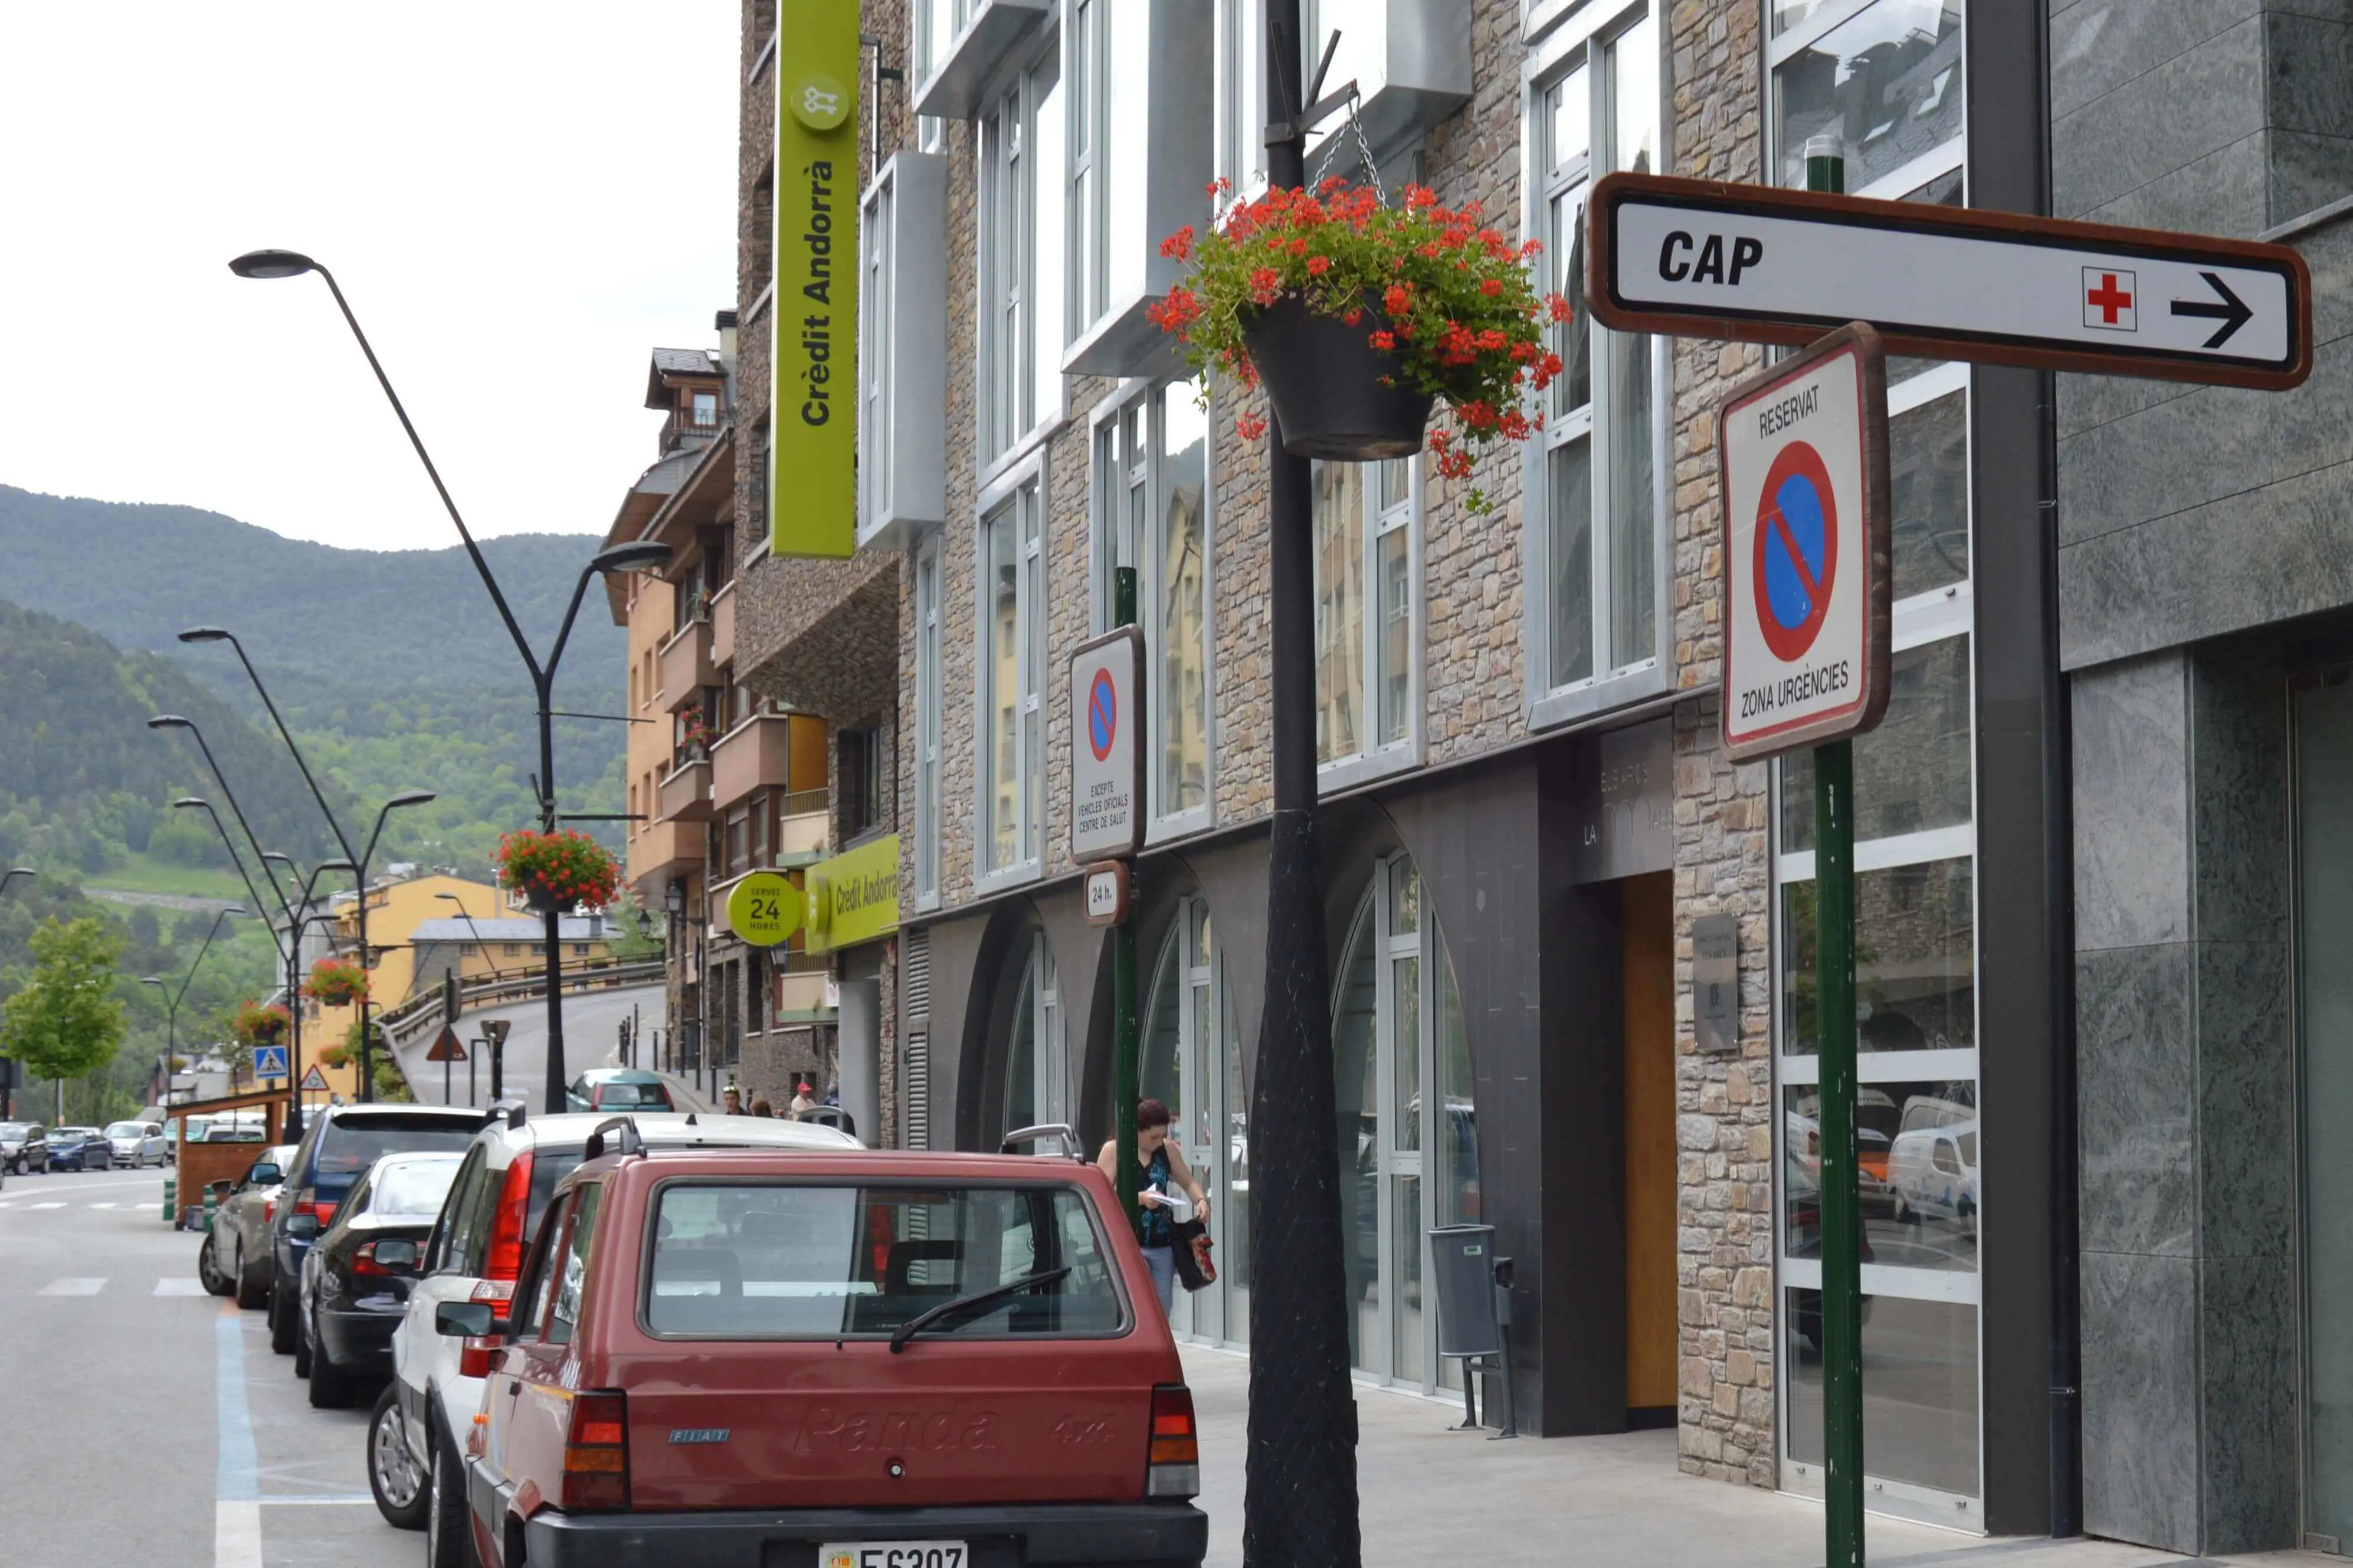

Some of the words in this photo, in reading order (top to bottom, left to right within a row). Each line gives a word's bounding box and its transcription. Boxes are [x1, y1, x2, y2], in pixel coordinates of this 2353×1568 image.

[803, 160, 833, 306] Andorrà
[1659, 231, 1764, 286] CAP
[801, 314, 830, 427] Crèdit
[1759, 383, 1820, 439] RESERVAT
[1742, 684, 1774, 719] ZONA
[1778, 660, 1849, 708] URGÈNCIES
[1090, 780, 1114, 798] EXCEPTE
[1077, 800, 1102, 817] VEHICLES
[1103, 793, 1128, 812] OFICIALS
[1079, 817, 1099, 834] CENTRE
[1100, 815, 1107, 829] DE
[1109, 811, 1126, 827] SALUT
[750, 887, 780, 896] SERVEI
[837, 877, 861, 916] Crèdit
[863, 863, 897, 907] Andorrà
[1093, 885, 1102, 903] 24
[1105, 884, 1112, 901] h.
[751, 898, 781, 920] 24
[750, 922, 780, 931] HORES
[673, 1430, 726, 1442] FIAT
[793, 1398, 999, 1451] Panda
